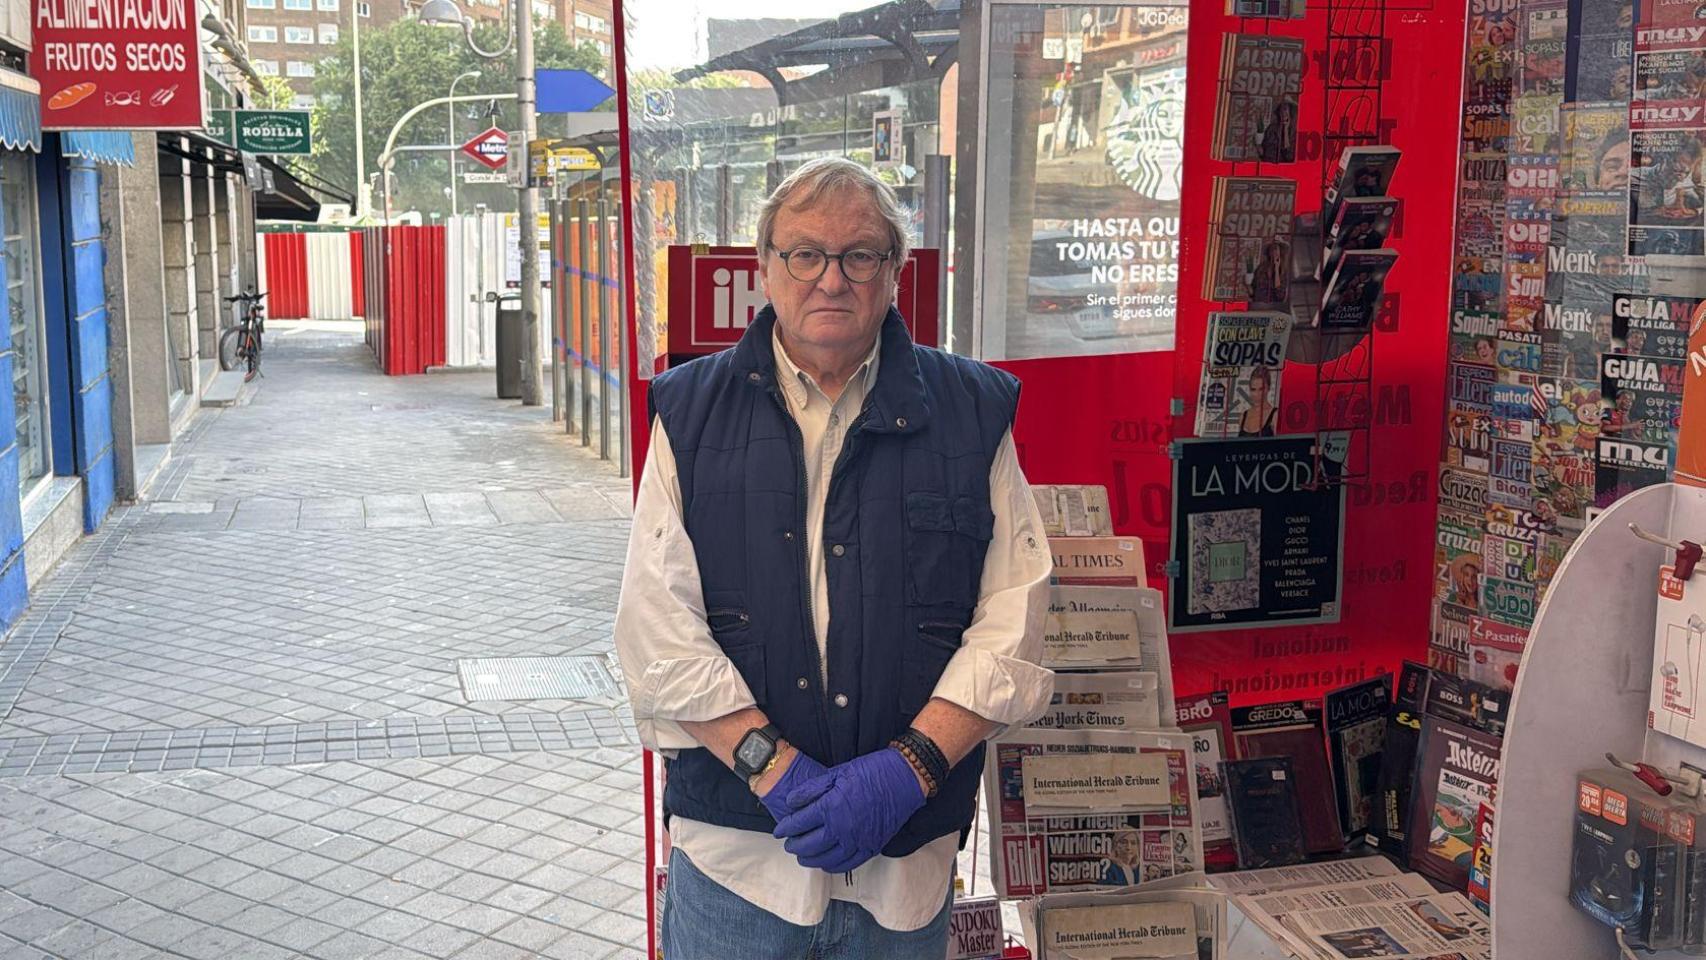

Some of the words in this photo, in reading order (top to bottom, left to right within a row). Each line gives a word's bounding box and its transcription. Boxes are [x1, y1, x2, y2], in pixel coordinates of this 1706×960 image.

[45, 43, 117, 71] FRUTOS
[125, 43, 186, 71] SECOS
[1231, 71, 1300, 97] SOPAS
[1466, 105, 1502, 115] SOPAS
[1631, 106, 1702, 123] muy
[242, 127, 304, 137] RODILLA
[1226, 191, 1292, 213] ALBUM
[1072, 217, 1144, 238] HASTA
[1147, 217, 1179, 237] QU
[1223, 213, 1291, 238] SOPAS
[1056, 240, 1135, 261] TOMAS
[1139, 240, 1166, 260] TU
[1548, 245, 1599, 275] Men's
[1091, 264, 1124, 284] NO
[1129, 263, 1178, 283] ERES
[1086, 292, 1106, 306] Sin
[1110, 294, 1120, 305] el
[1124, 293, 1166, 305] primer
[1112, 308, 1153, 321] sigues
[1543, 303, 1594, 333] Men's
[1654, 321, 1675, 330] LIGA
[1498, 330, 1542, 345] PASATI
[1213, 342, 1281, 367] SOPAS
[1604, 358, 1660, 382] GUÍA
[1643, 383, 1665, 392] LIGA
[1225, 452, 1279, 463] LEYENDAS
[1284, 451, 1297, 460] DE
[1192, 464, 1225, 497] LA
[1288, 527, 1307, 535] DIOR
[1284, 536, 1309, 545] GUCCI
[1071, 554, 1125, 569] TIMES
[1284, 568, 1307, 578] PRADA
[1280, 589, 1310, 599] VERSACE
[1064, 631, 1094, 643] Herald
[1095, 630, 1131, 642] Tribune
[1440, 690, 1464, 705] BOSS
[1056, 711, 1085, 729] York
[1086, 711, 1126, 726] Times
[1033, 776, 1093, 790] International
[1094, 775, 1124, 788] Herald
[1125, 774, 1161, 787] Tribune
[1049, 831, 1113, 855] wirklich
[1006, 839, 1043, 888] Bild
[1049, 858, 1111, 883] sparen?
[949, 909, 999, 936] SUDOKU
[1056, 929, 1117, 943] International
[1118, 927, 1149, 939] Herald
[1150, 925, 1187, 937] Tribune
[958, 932, 996, 955] Master
